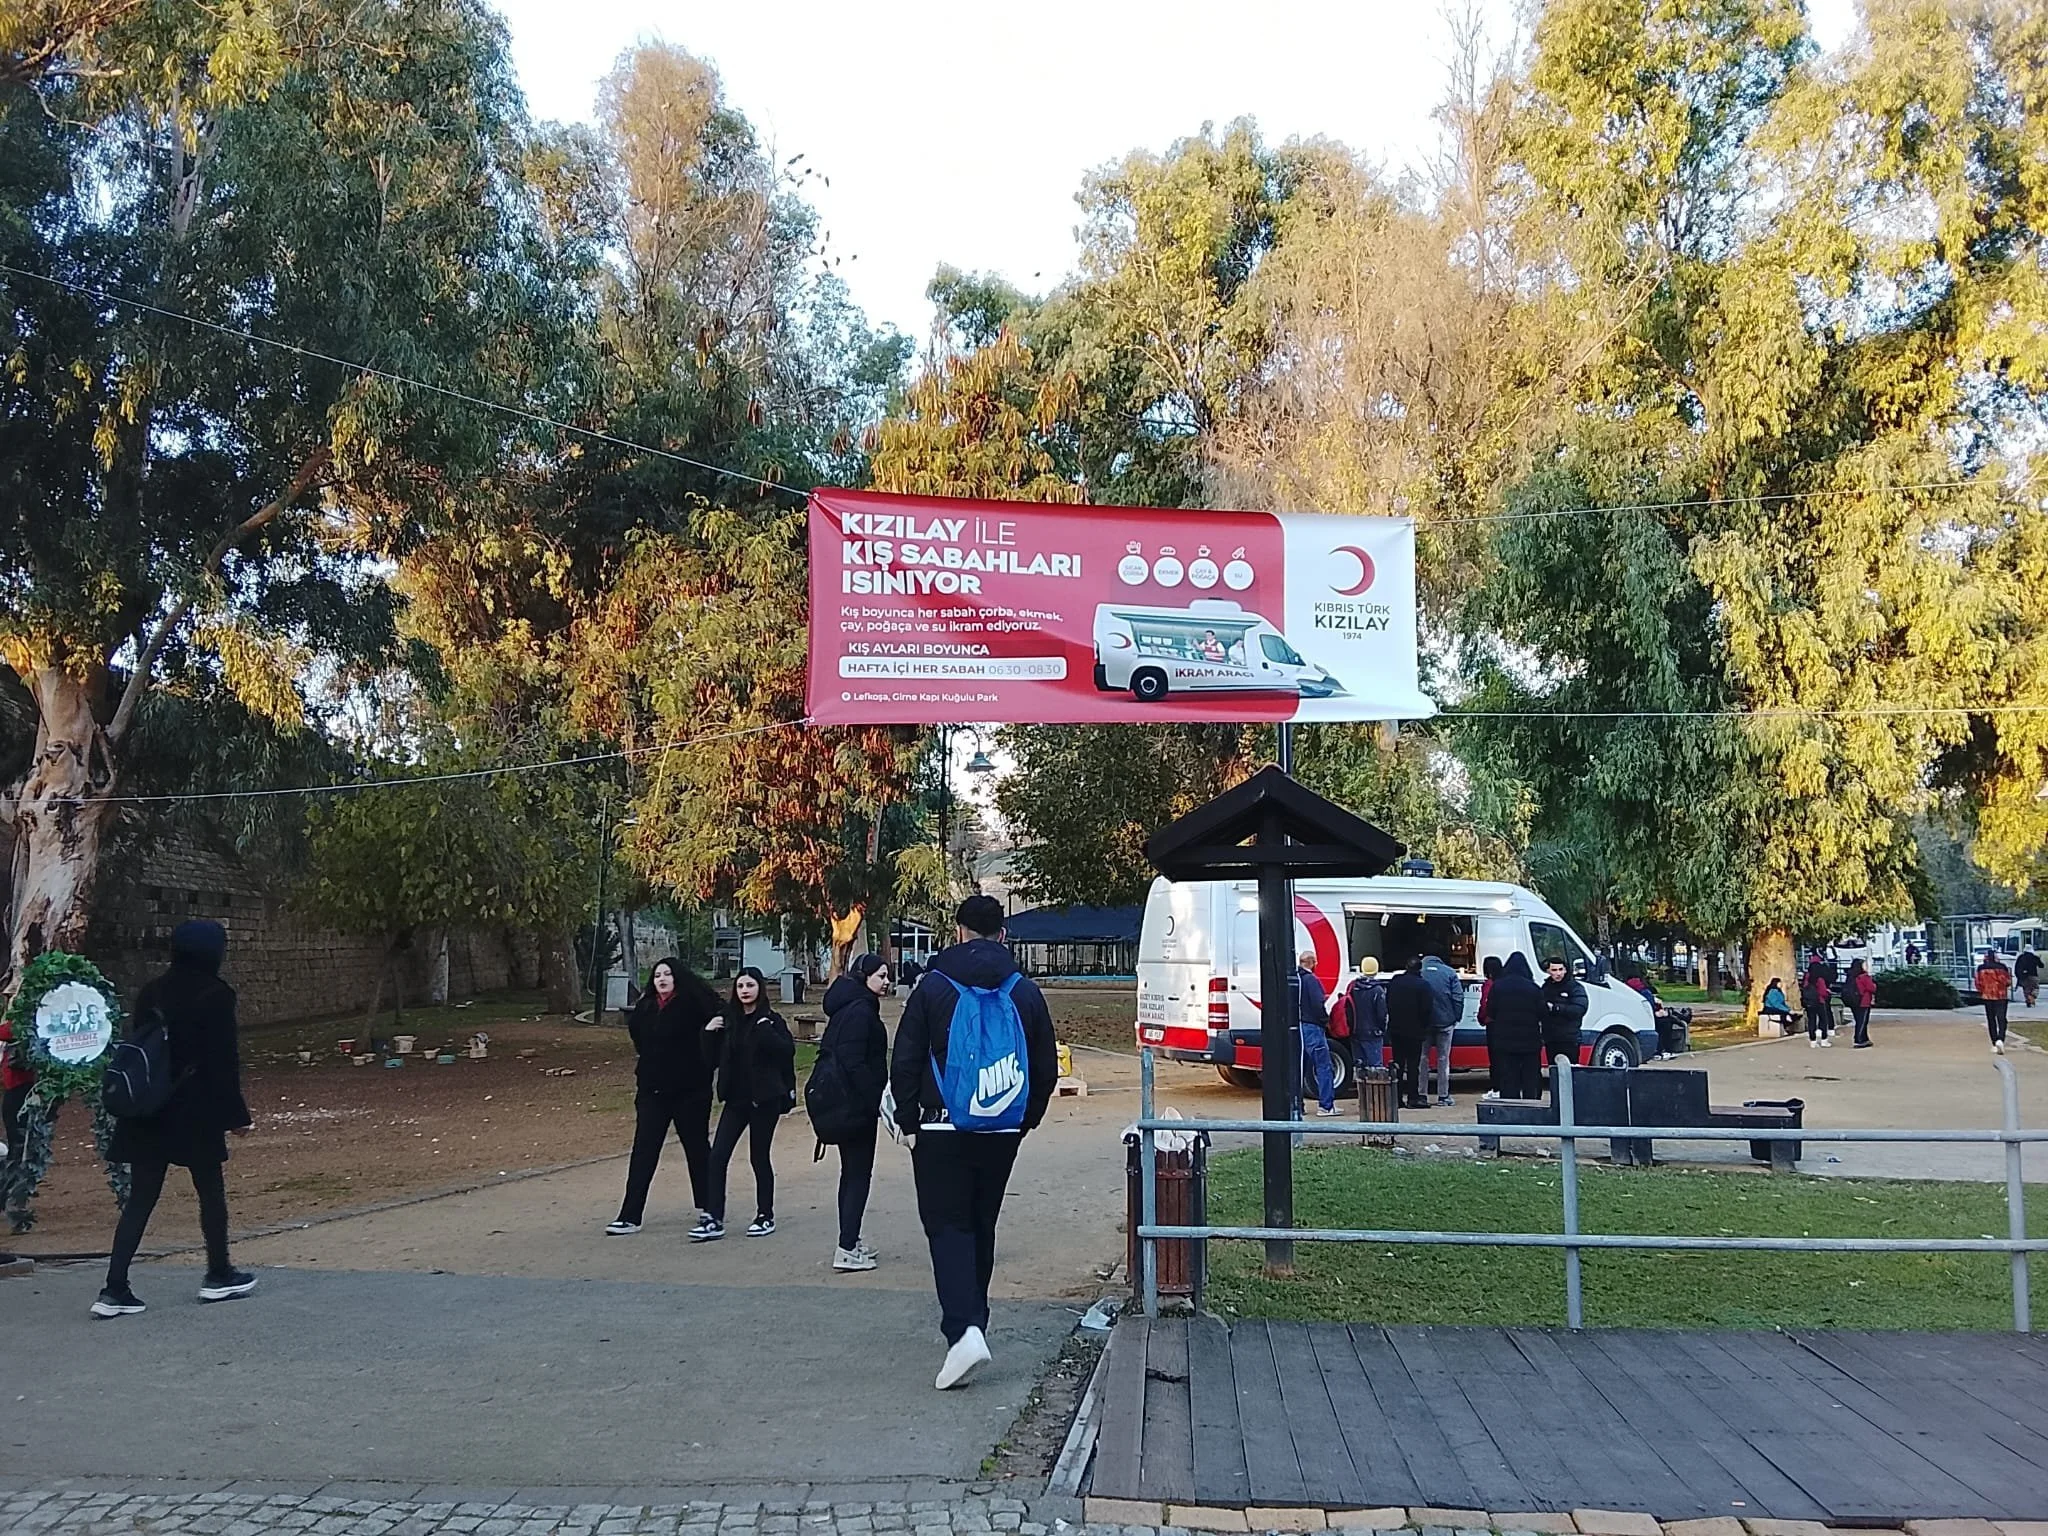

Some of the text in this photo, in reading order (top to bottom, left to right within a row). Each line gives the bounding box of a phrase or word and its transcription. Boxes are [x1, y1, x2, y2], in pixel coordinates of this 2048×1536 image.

[841, 512, 1016, 546] KIZILAY İLE
[843, 540, 1081, 578] KIŞ SABAHLARI
[842, 570, 982, 595] ISINIYOR
[841, 606, 1064, 622] Kış boyunca her sabah çorba, ekmek,
[1314, 602, 1391, 615] KIBRIS TÜRK
[840, 619, 1042, 633] çay, poğaça ve su ikram ediyoruz.
[1315, 614, 1390, 631] KIZILAY
[1343, 632, 1362, 640] 1974
[849, 643, 990, 656] KIŞ AYLARI BOYUNCA
[848, 663, 890, 673] HAFTA
[893, 661, 909, 676] İÇİ
[913, 664, 938, 674] HER
[941, 664, 985, 674] SABAH
[941, 693, 975, 703] Kuğulu
[976, 693, 999, 702] Park
